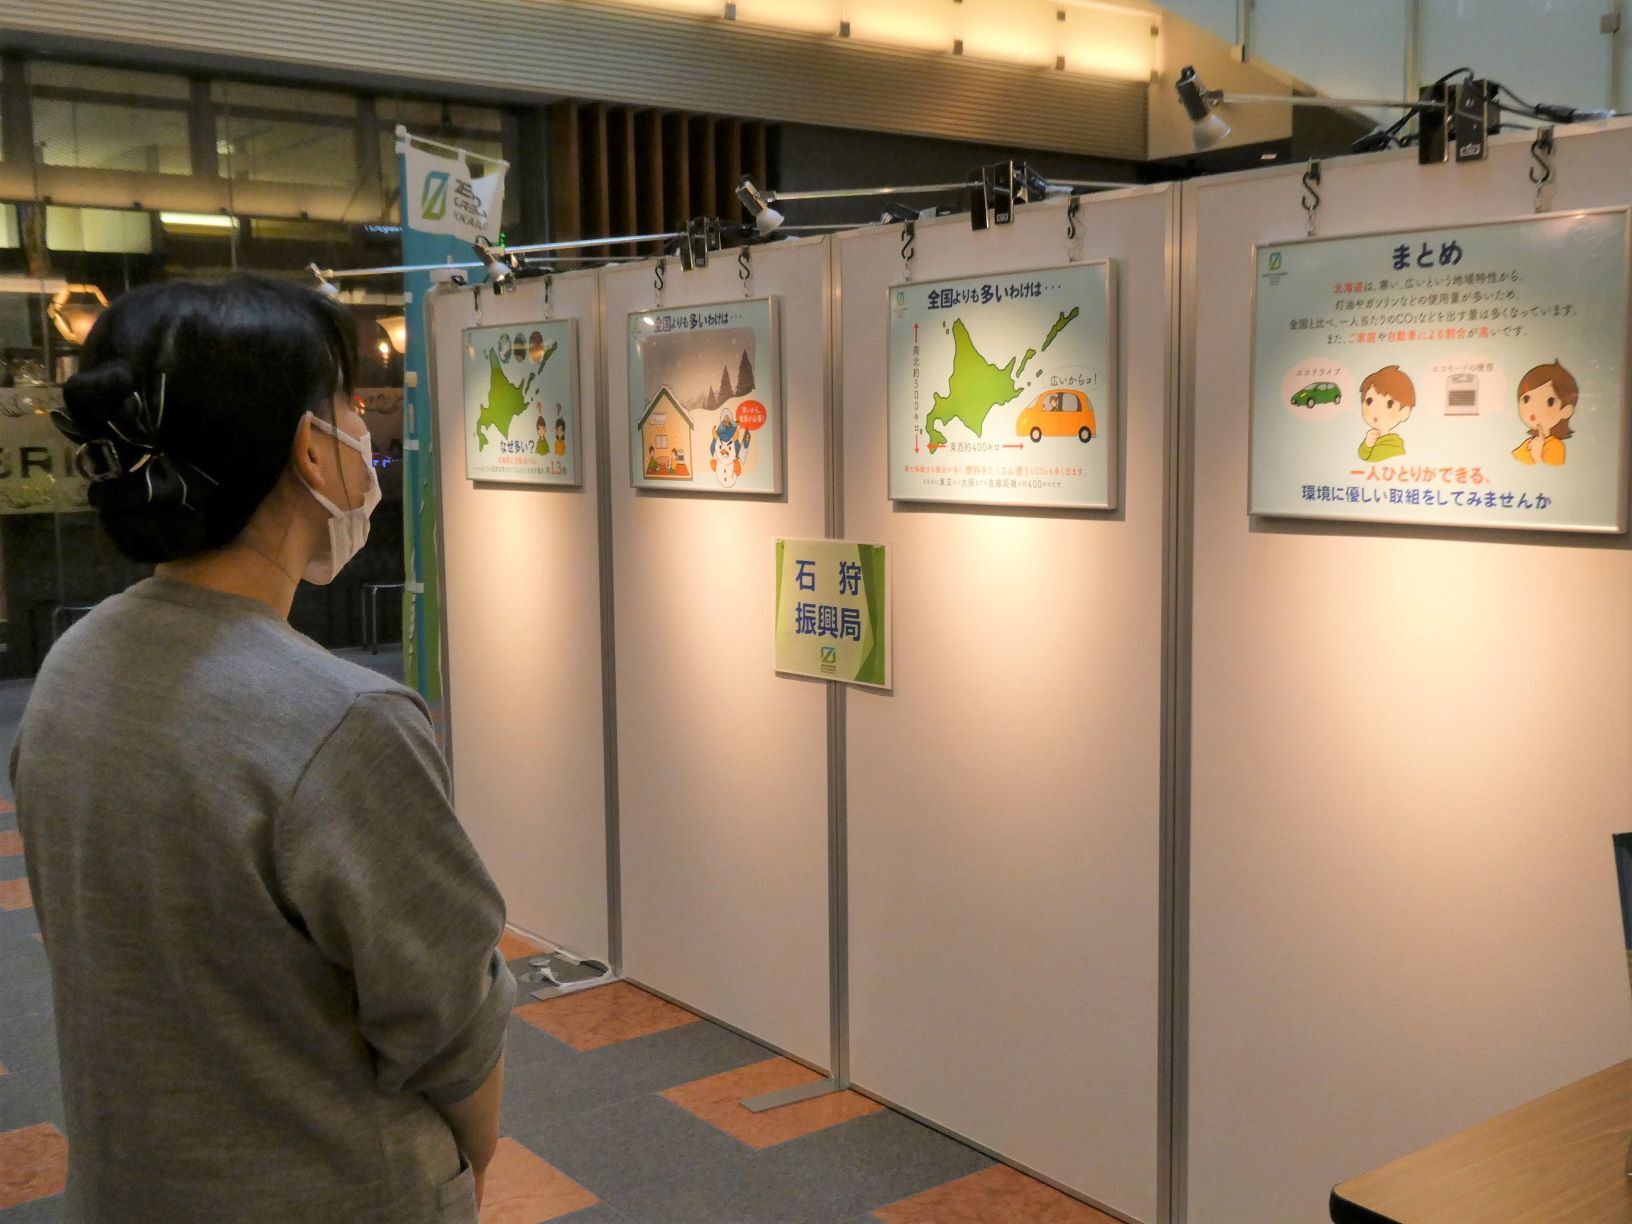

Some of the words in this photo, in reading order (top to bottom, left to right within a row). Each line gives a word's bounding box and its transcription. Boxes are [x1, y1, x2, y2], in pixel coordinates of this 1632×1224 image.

[1392, 240, 1463, 271] まとめ
[1301, 485, 1553, 510] 環境に優しい取組をしてみませんか
[796, 602, 861, 641] 振興局
